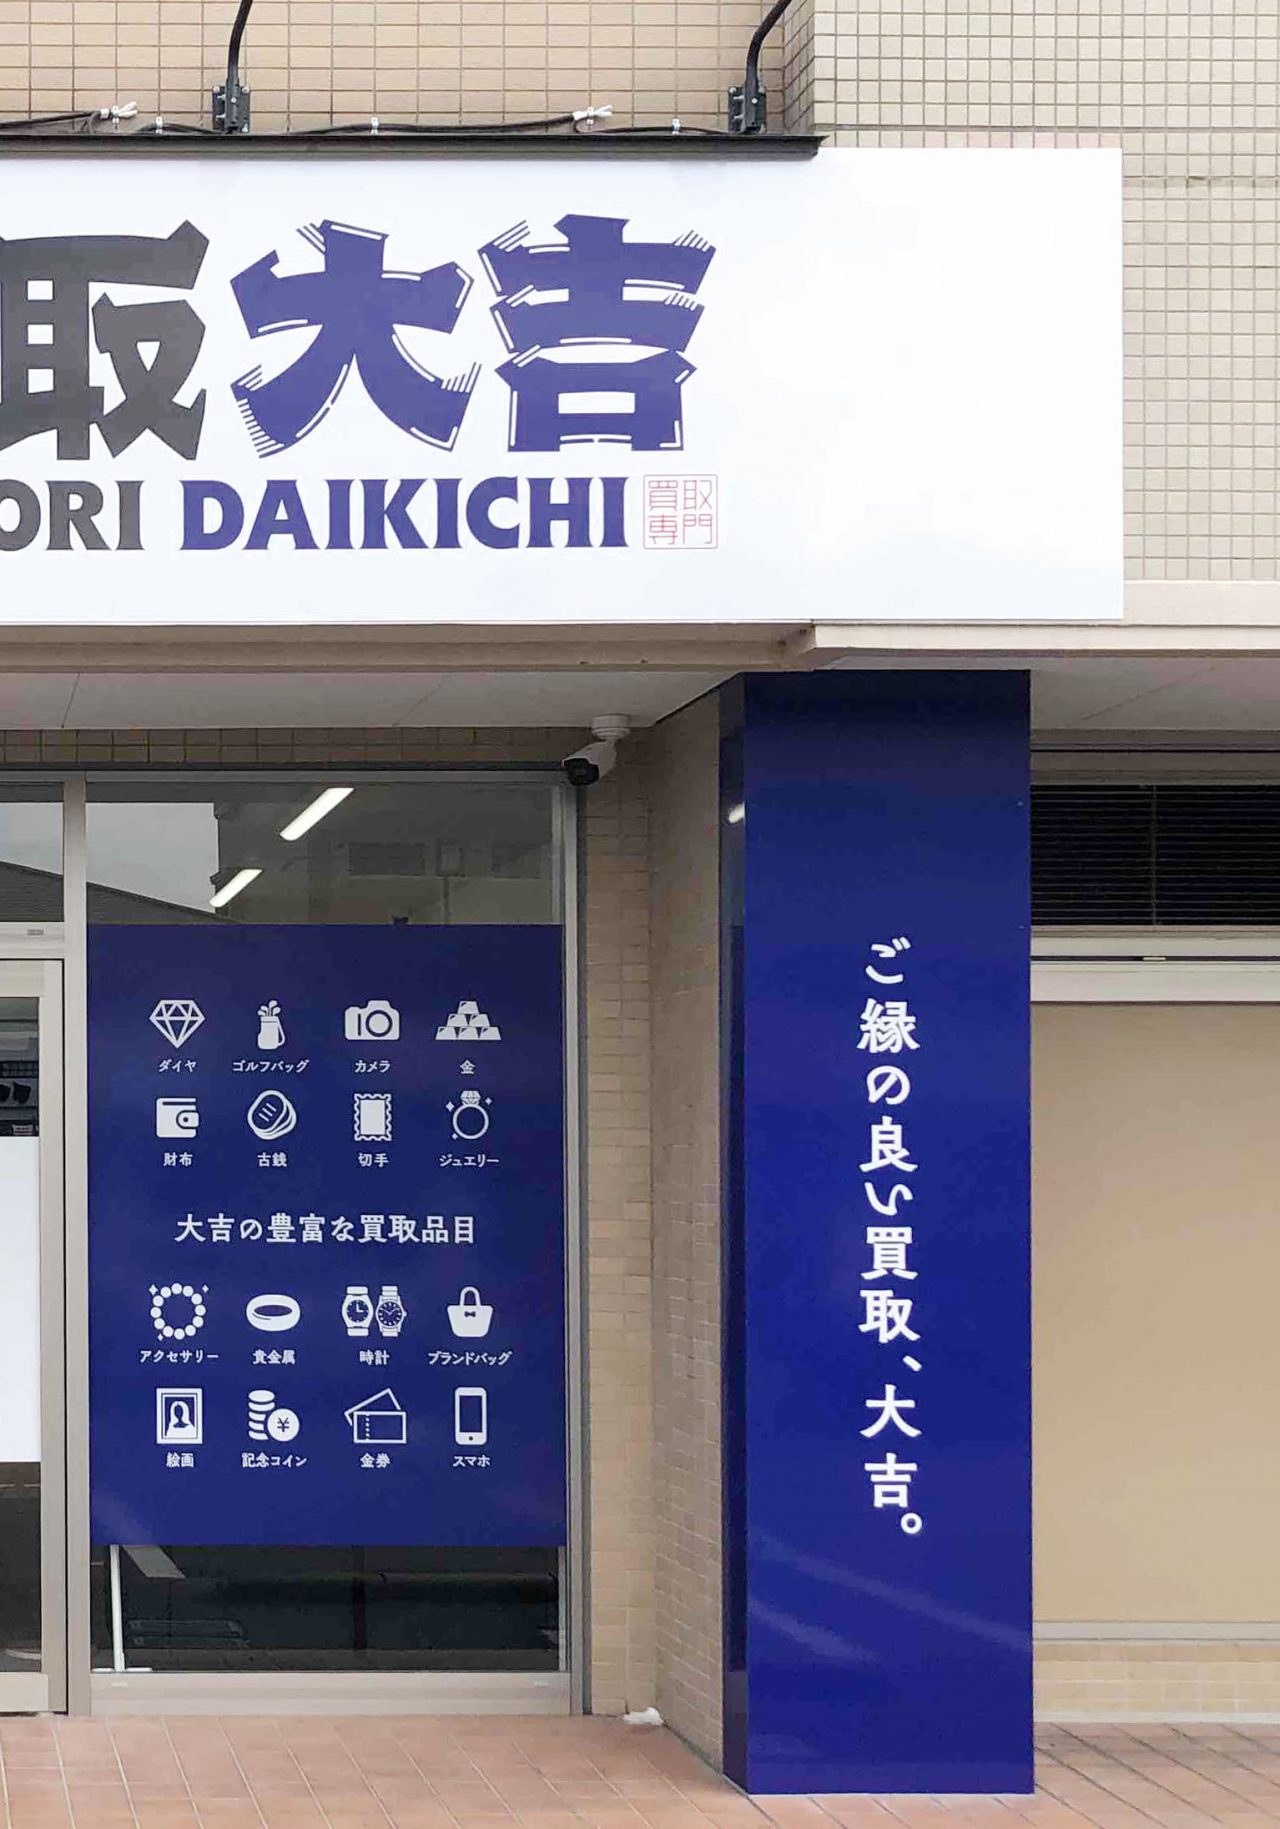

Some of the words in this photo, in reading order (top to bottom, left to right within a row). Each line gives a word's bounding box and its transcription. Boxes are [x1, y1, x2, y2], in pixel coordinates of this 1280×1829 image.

[180, 476, 628, 550] DAIKICHI
[159, 1059, 197, 1073] ダイヤ
[232, 1059, 309, 1073] ゴルフバッグ
[354, 1059, 391, 1073] カメラ
[460, 1060, 475, 1074] 金
[164, 1152, 193, 1167] 財布
[257, 1152, 287, 1167] 古銭
[358, 1152, 388, 1167] 切手
[440, 1154, 499, 1168] ジュエリー
[175, 1213, 475, 1244] 大吉の豊富な買取品目
[857, 937, 922, 1534] ご縁の良い買取、大吉。
[140, 1350, 219, 1364] アクセサリー
[253, 1349, 296, 1365] 貴金属
[359, 1350, 390, 1365] 時計
[427, 1350, 512, 1366] ブランドバッグ
[166, 1452, 194, 1467] 絵画
[242, 1452, 307, 1468] 記念コイン
[360, 1453, 390, 1468] 金券
[453, 1455, 491, 1468] スマホ
